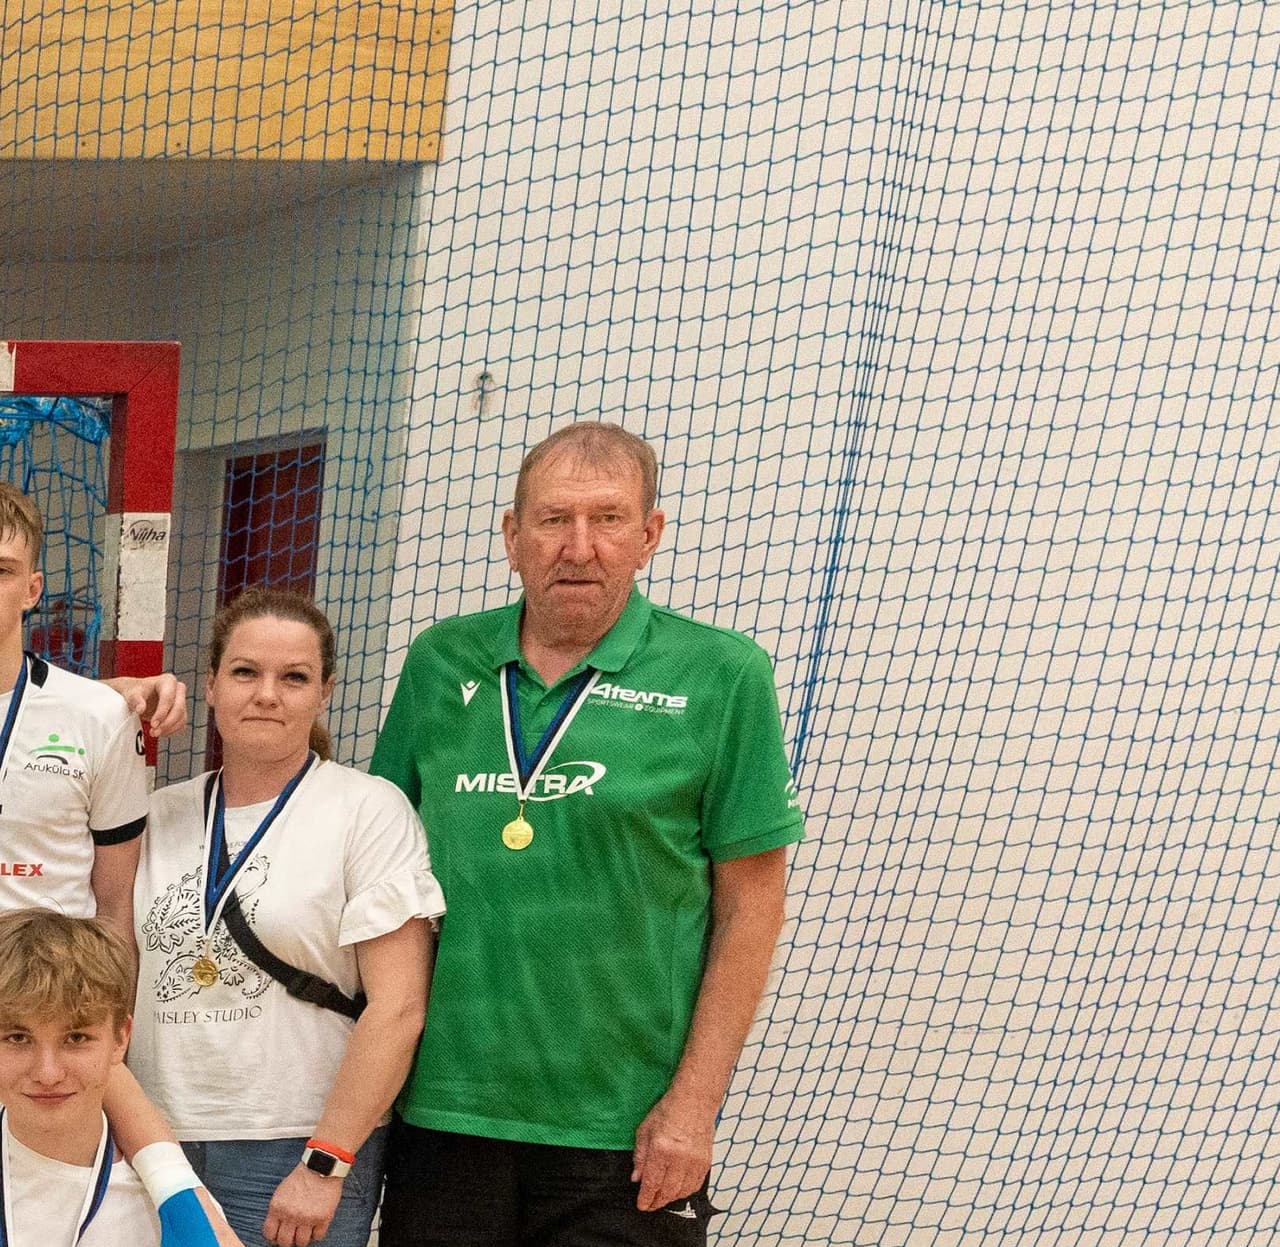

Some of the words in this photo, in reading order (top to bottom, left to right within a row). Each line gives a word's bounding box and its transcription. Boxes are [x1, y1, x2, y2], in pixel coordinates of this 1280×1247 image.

[24, 761, 70, 777] Aruküla
[72, 768, 86, 781] SK
[454, 772, 595, 796] MISTRA
[202, 1005, 263, 1024] STUDIO
